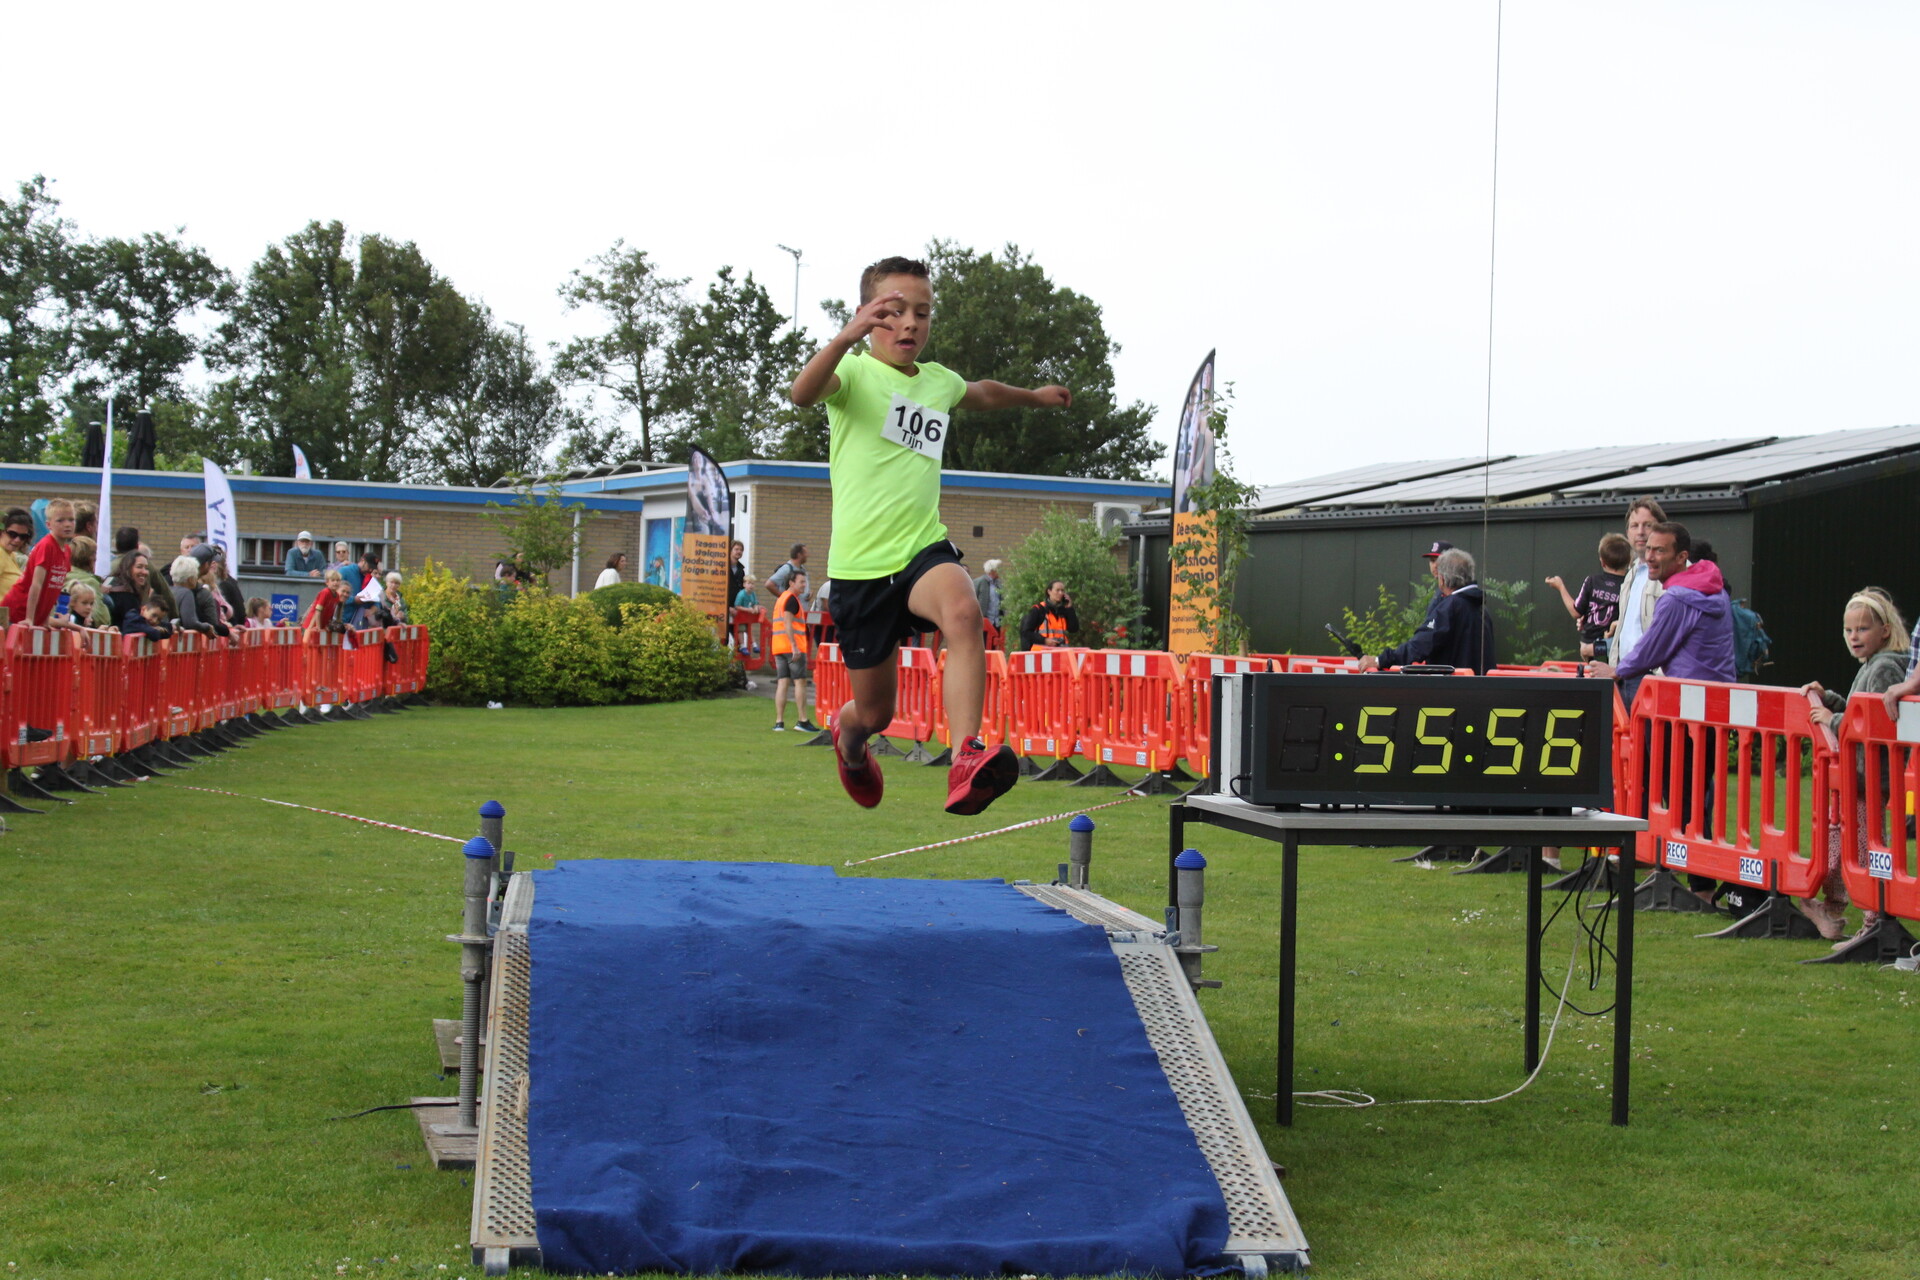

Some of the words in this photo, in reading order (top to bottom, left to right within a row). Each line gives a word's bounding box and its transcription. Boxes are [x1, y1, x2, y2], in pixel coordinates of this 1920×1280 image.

[895, 405, 943, 442] 106
[902, 429, 923, 450] Tijn
[1667, 843, 1687, 859] RECO
[1740, 858, 1762, 876] RECO
[1869, 852, 1891, 871] RECO
